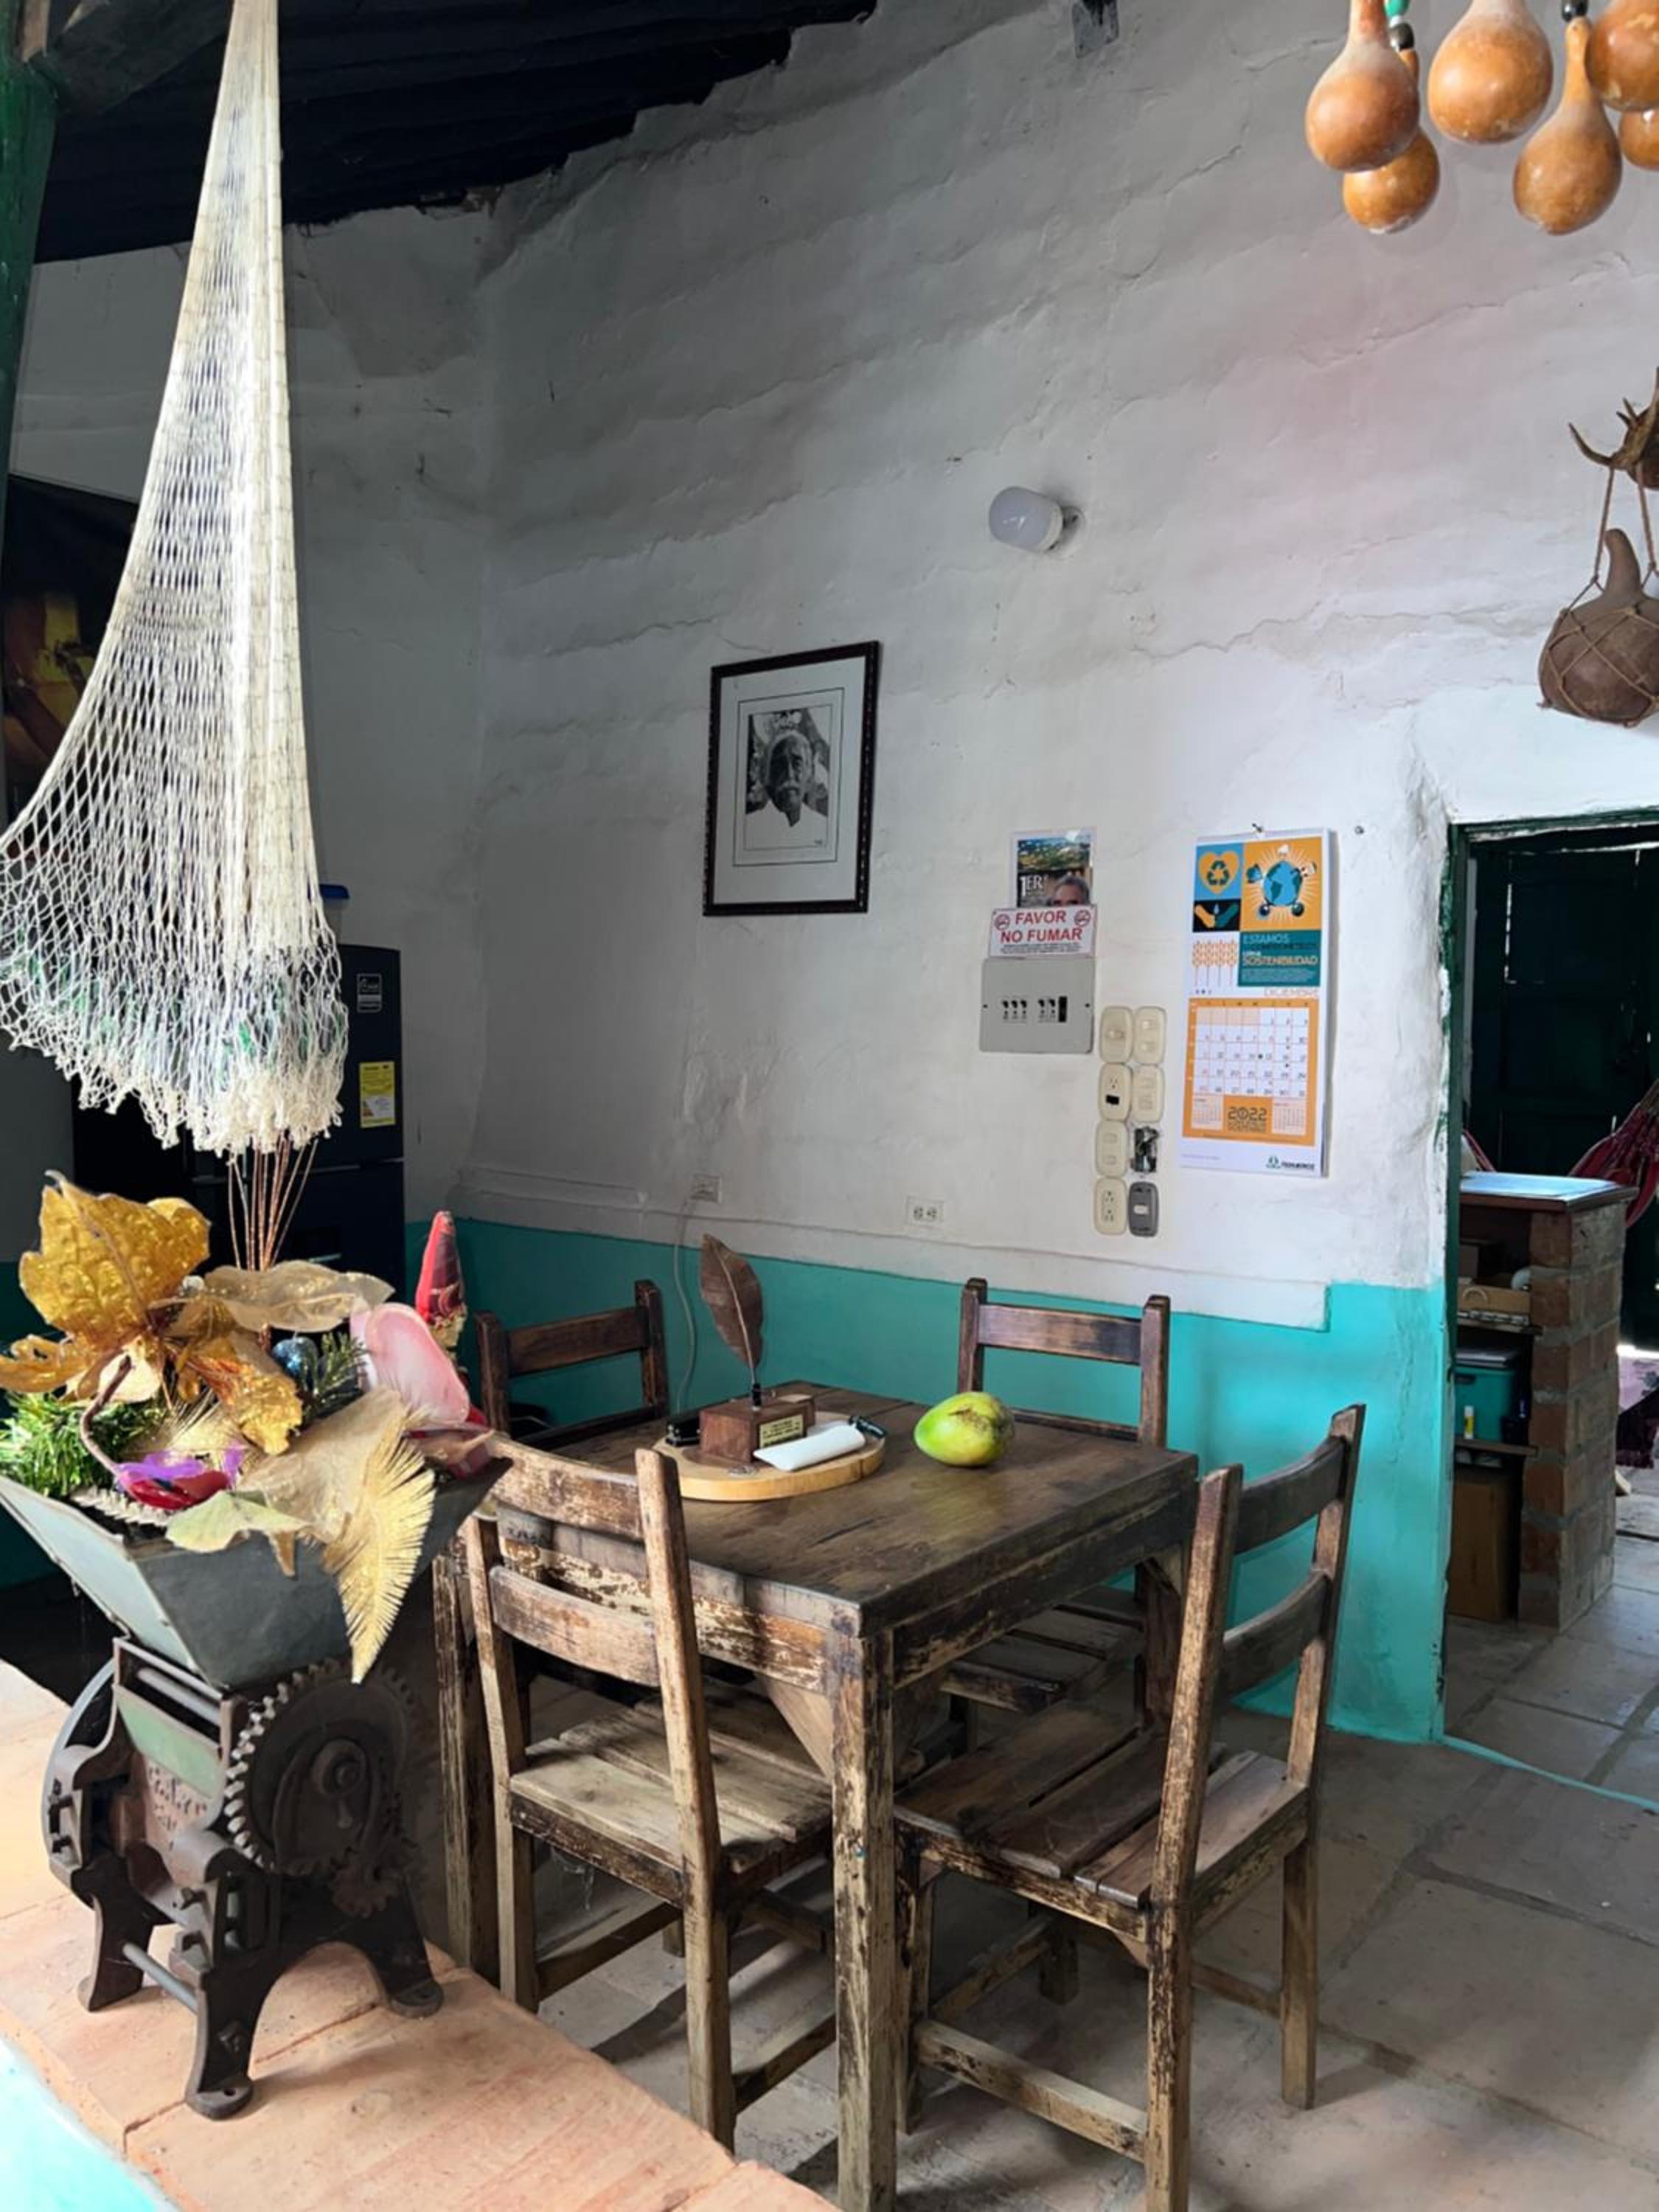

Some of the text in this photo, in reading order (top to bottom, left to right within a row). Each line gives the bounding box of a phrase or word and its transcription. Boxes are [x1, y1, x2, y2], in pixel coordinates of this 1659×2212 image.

[1015, 910, 1066, 924] FAVOR
[1001, 928, 1082, 943] NO FUMAR
[1242, 933, 1289, 944] ESTAMOS
[1227, 1106, 1267, 1121] 2022
